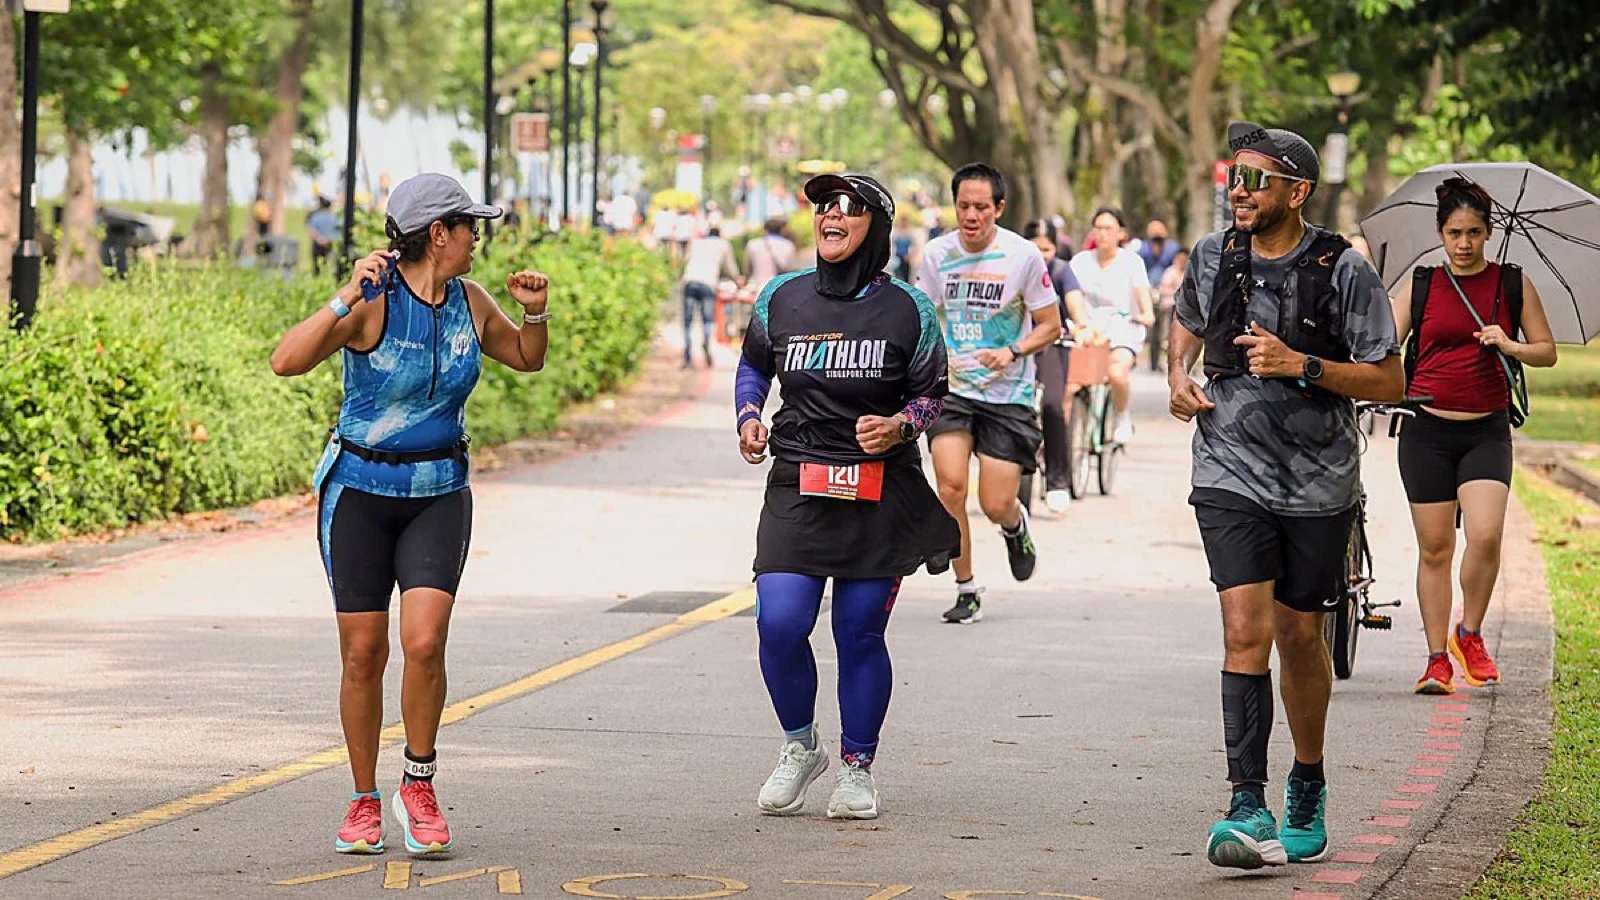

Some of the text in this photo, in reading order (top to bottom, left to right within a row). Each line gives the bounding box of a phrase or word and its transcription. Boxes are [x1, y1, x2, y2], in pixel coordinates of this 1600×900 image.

[945, 281, 1005, 301] TRIATHLON
[789, 332, 844, 342] TRIFACTOR
[952, 322, 983, 340] 5039
[783, 339, 888, 373] TRIATHLON
[825, 370, 863, 378] SINGAPORE
[828, 464, 860, 486] 120
